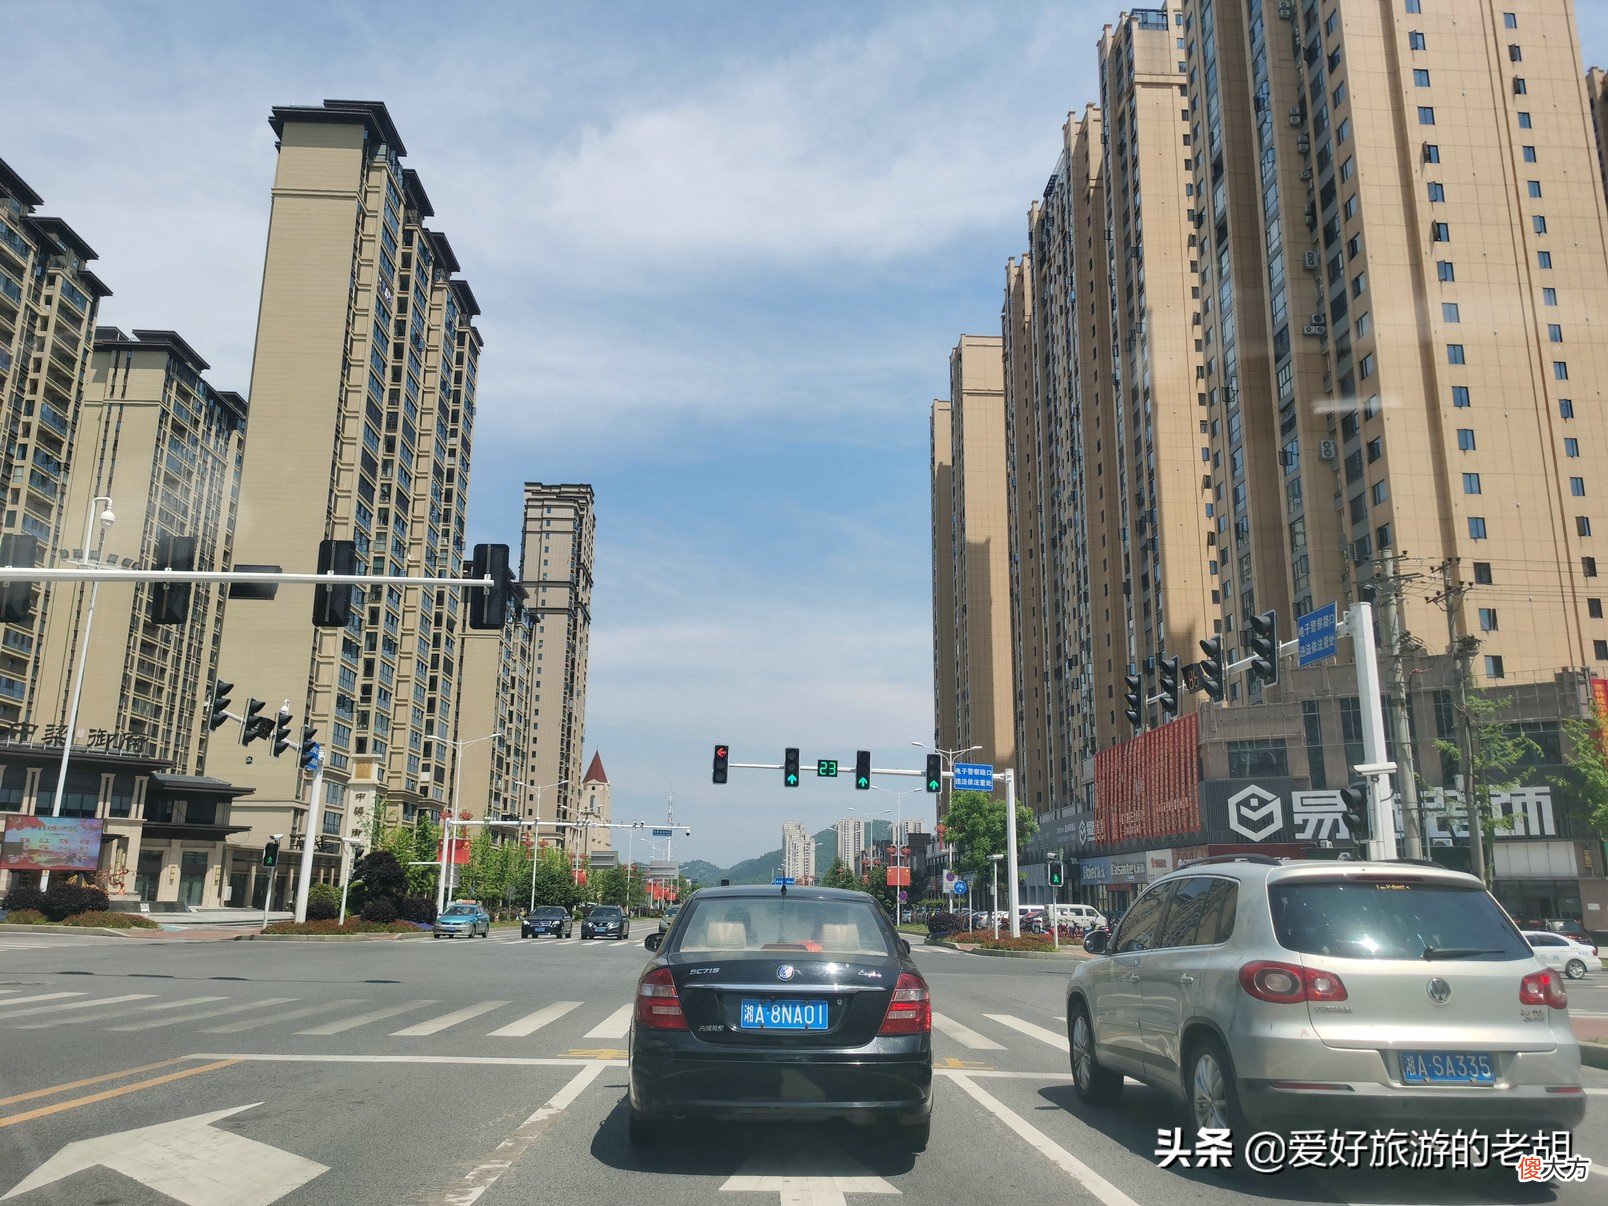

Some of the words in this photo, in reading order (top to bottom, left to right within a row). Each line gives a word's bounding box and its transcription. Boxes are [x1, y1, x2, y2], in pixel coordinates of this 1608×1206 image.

[819, 761, 837, 776] 23
[955, 767, 992, 777] 电子警察路口
